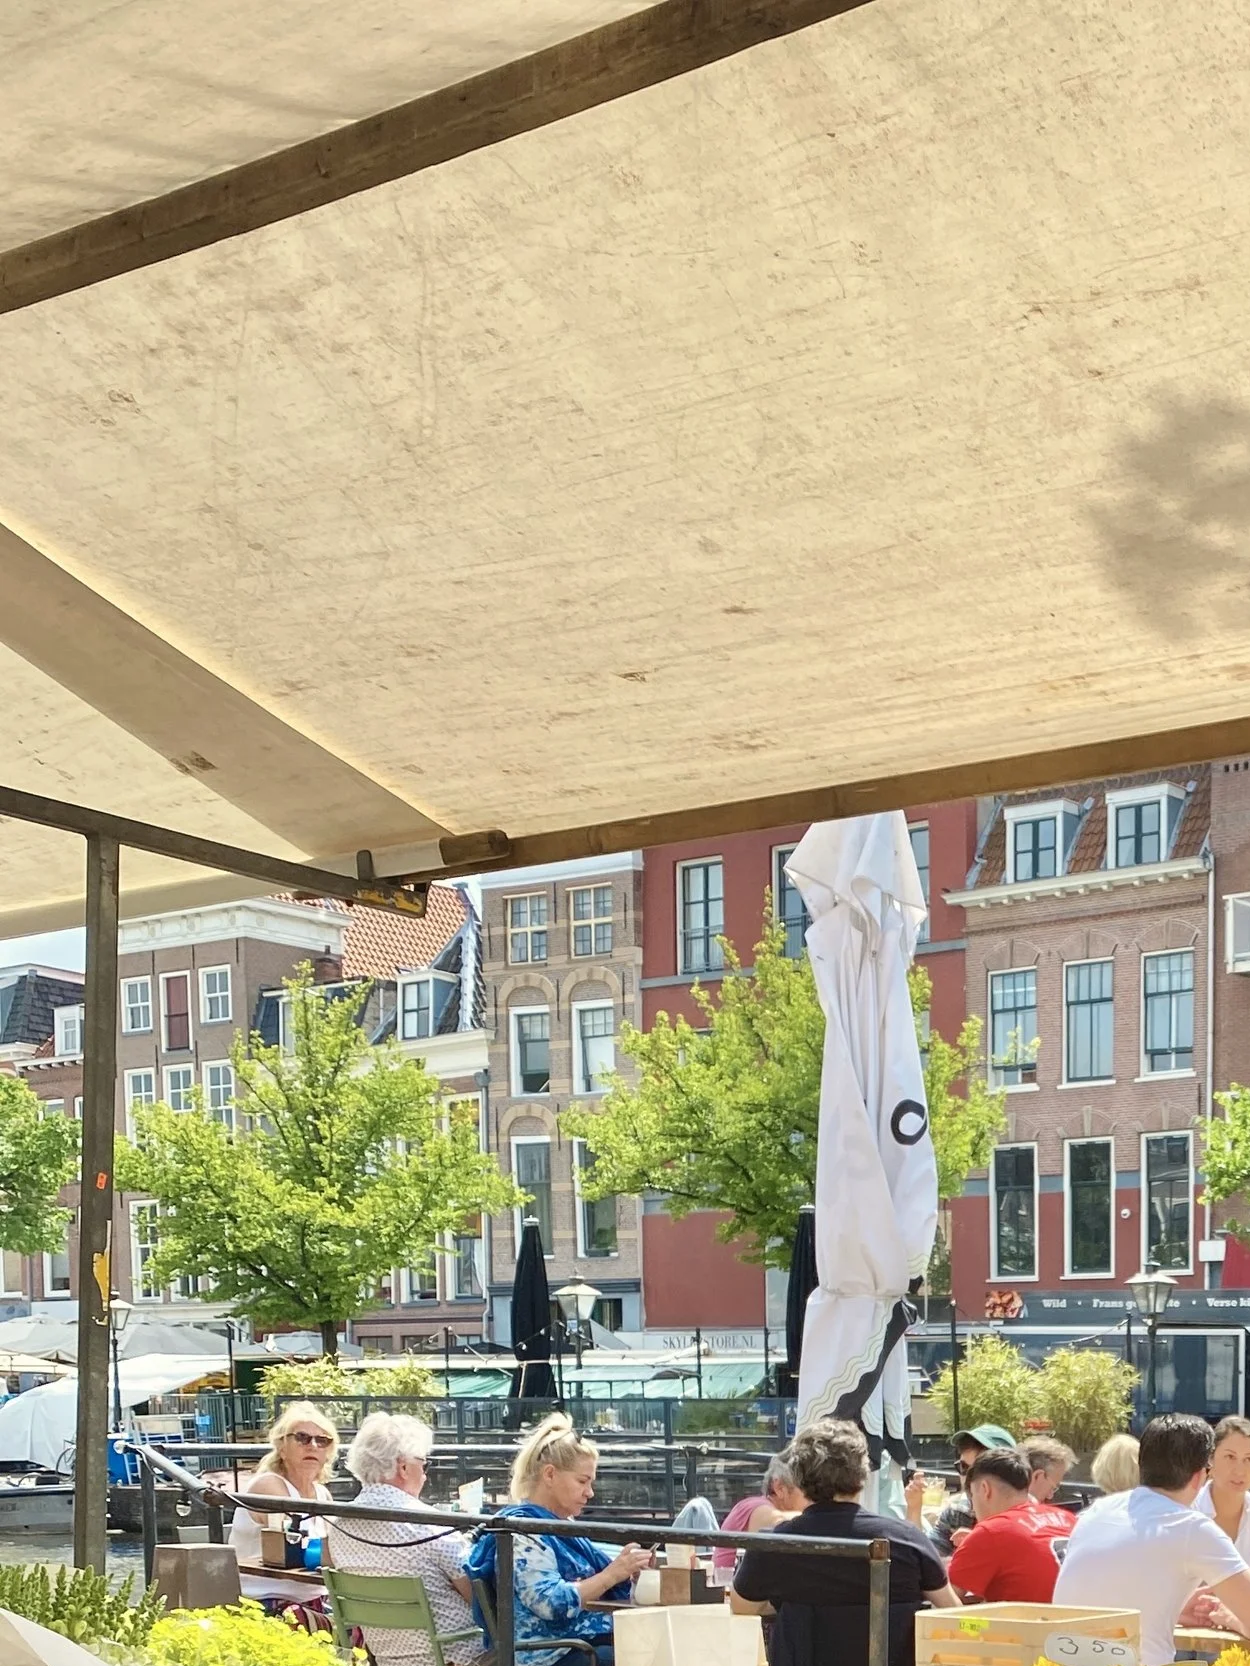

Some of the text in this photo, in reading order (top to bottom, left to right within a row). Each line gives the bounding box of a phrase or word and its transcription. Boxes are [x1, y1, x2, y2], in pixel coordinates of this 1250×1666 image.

[1042, 1299, 1067, 1308] Wild
[1092, 1299, 1123, 1308] Frans
[1206, 1298, 1237, 1307] Verse
